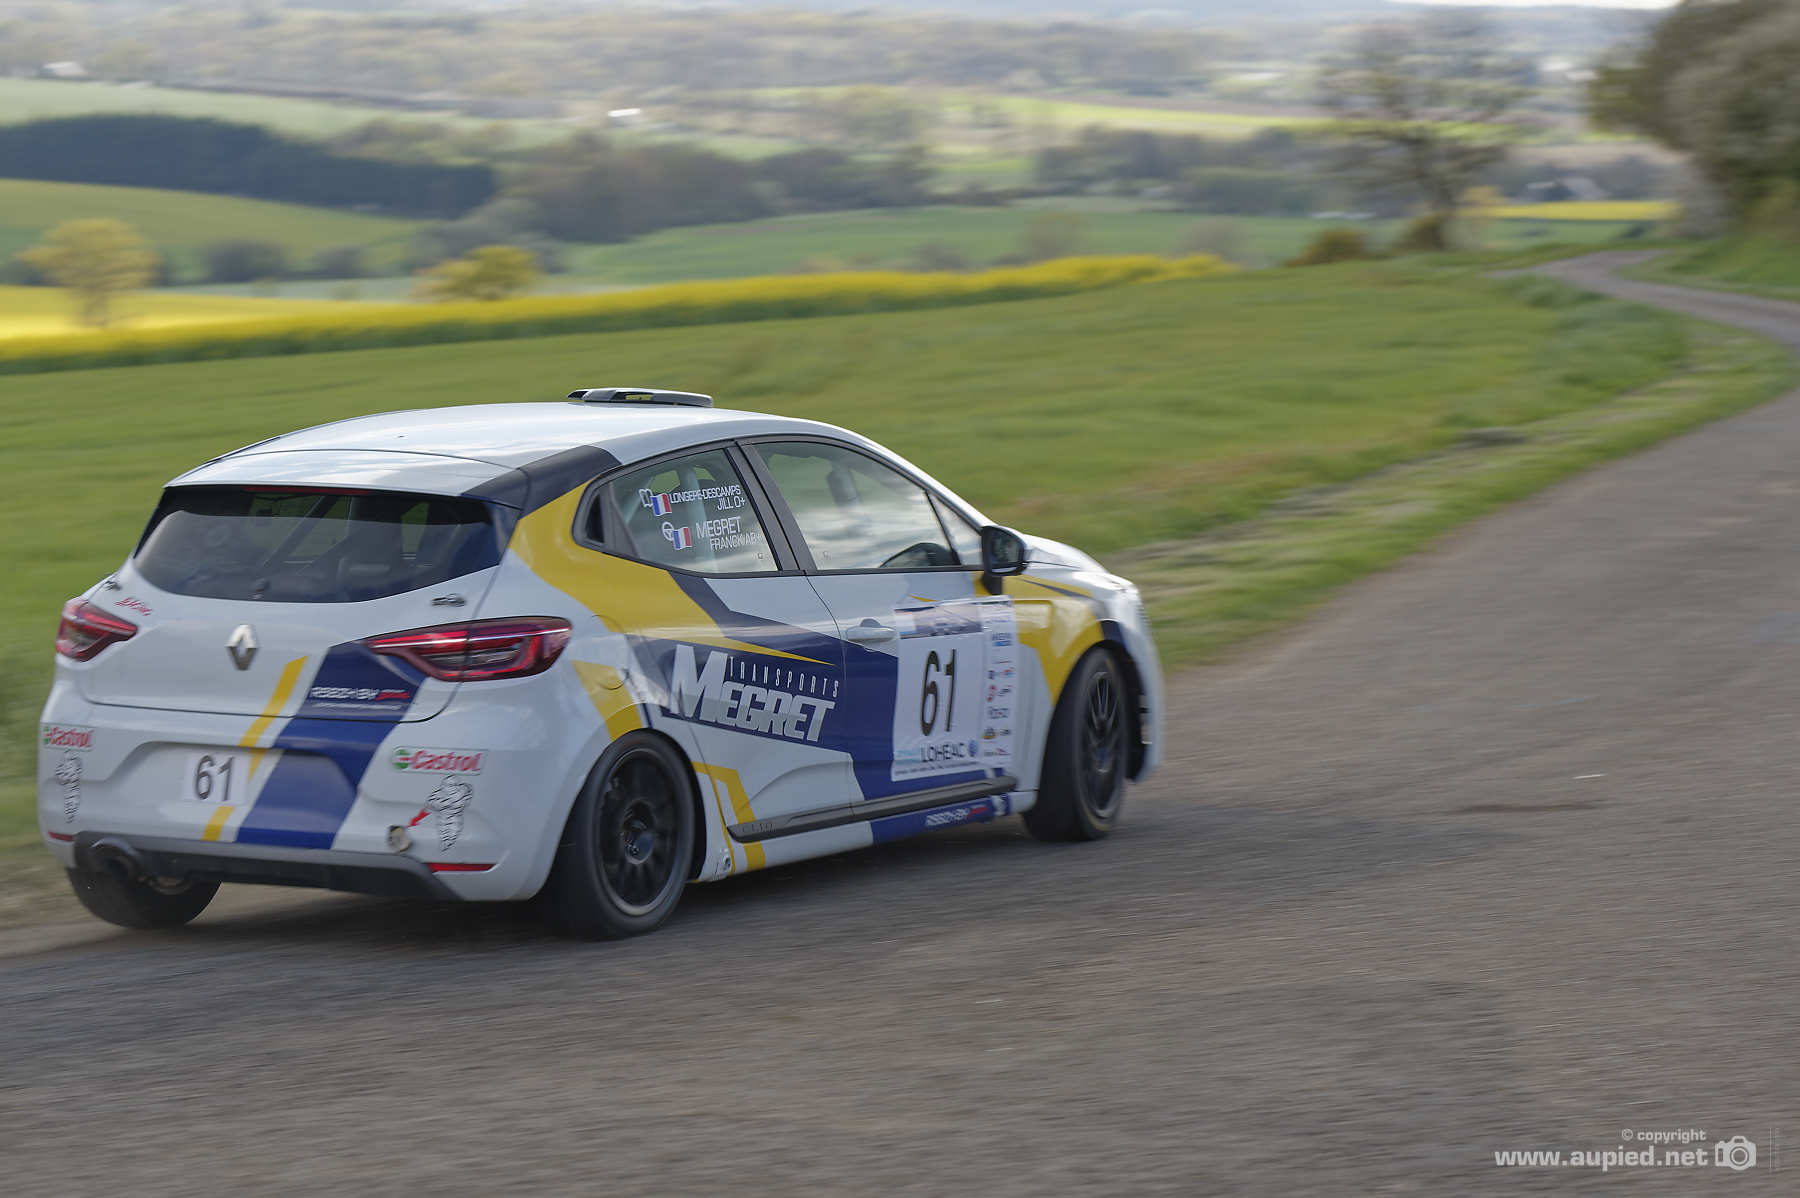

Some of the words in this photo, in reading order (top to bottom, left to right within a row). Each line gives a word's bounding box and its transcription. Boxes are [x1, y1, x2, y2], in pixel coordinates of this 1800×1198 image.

[717, 498, 734, 511] JILL
[695, 516, 742, 539] MEGRET
[670, 644, 836, 742] MEGRET
[728, 656, 839, 698] TRANSPORTS
[920, 649, 957, 737] 61
[195, 755, 235, 802] 61
[411, 750, 483, 772] Castrol
